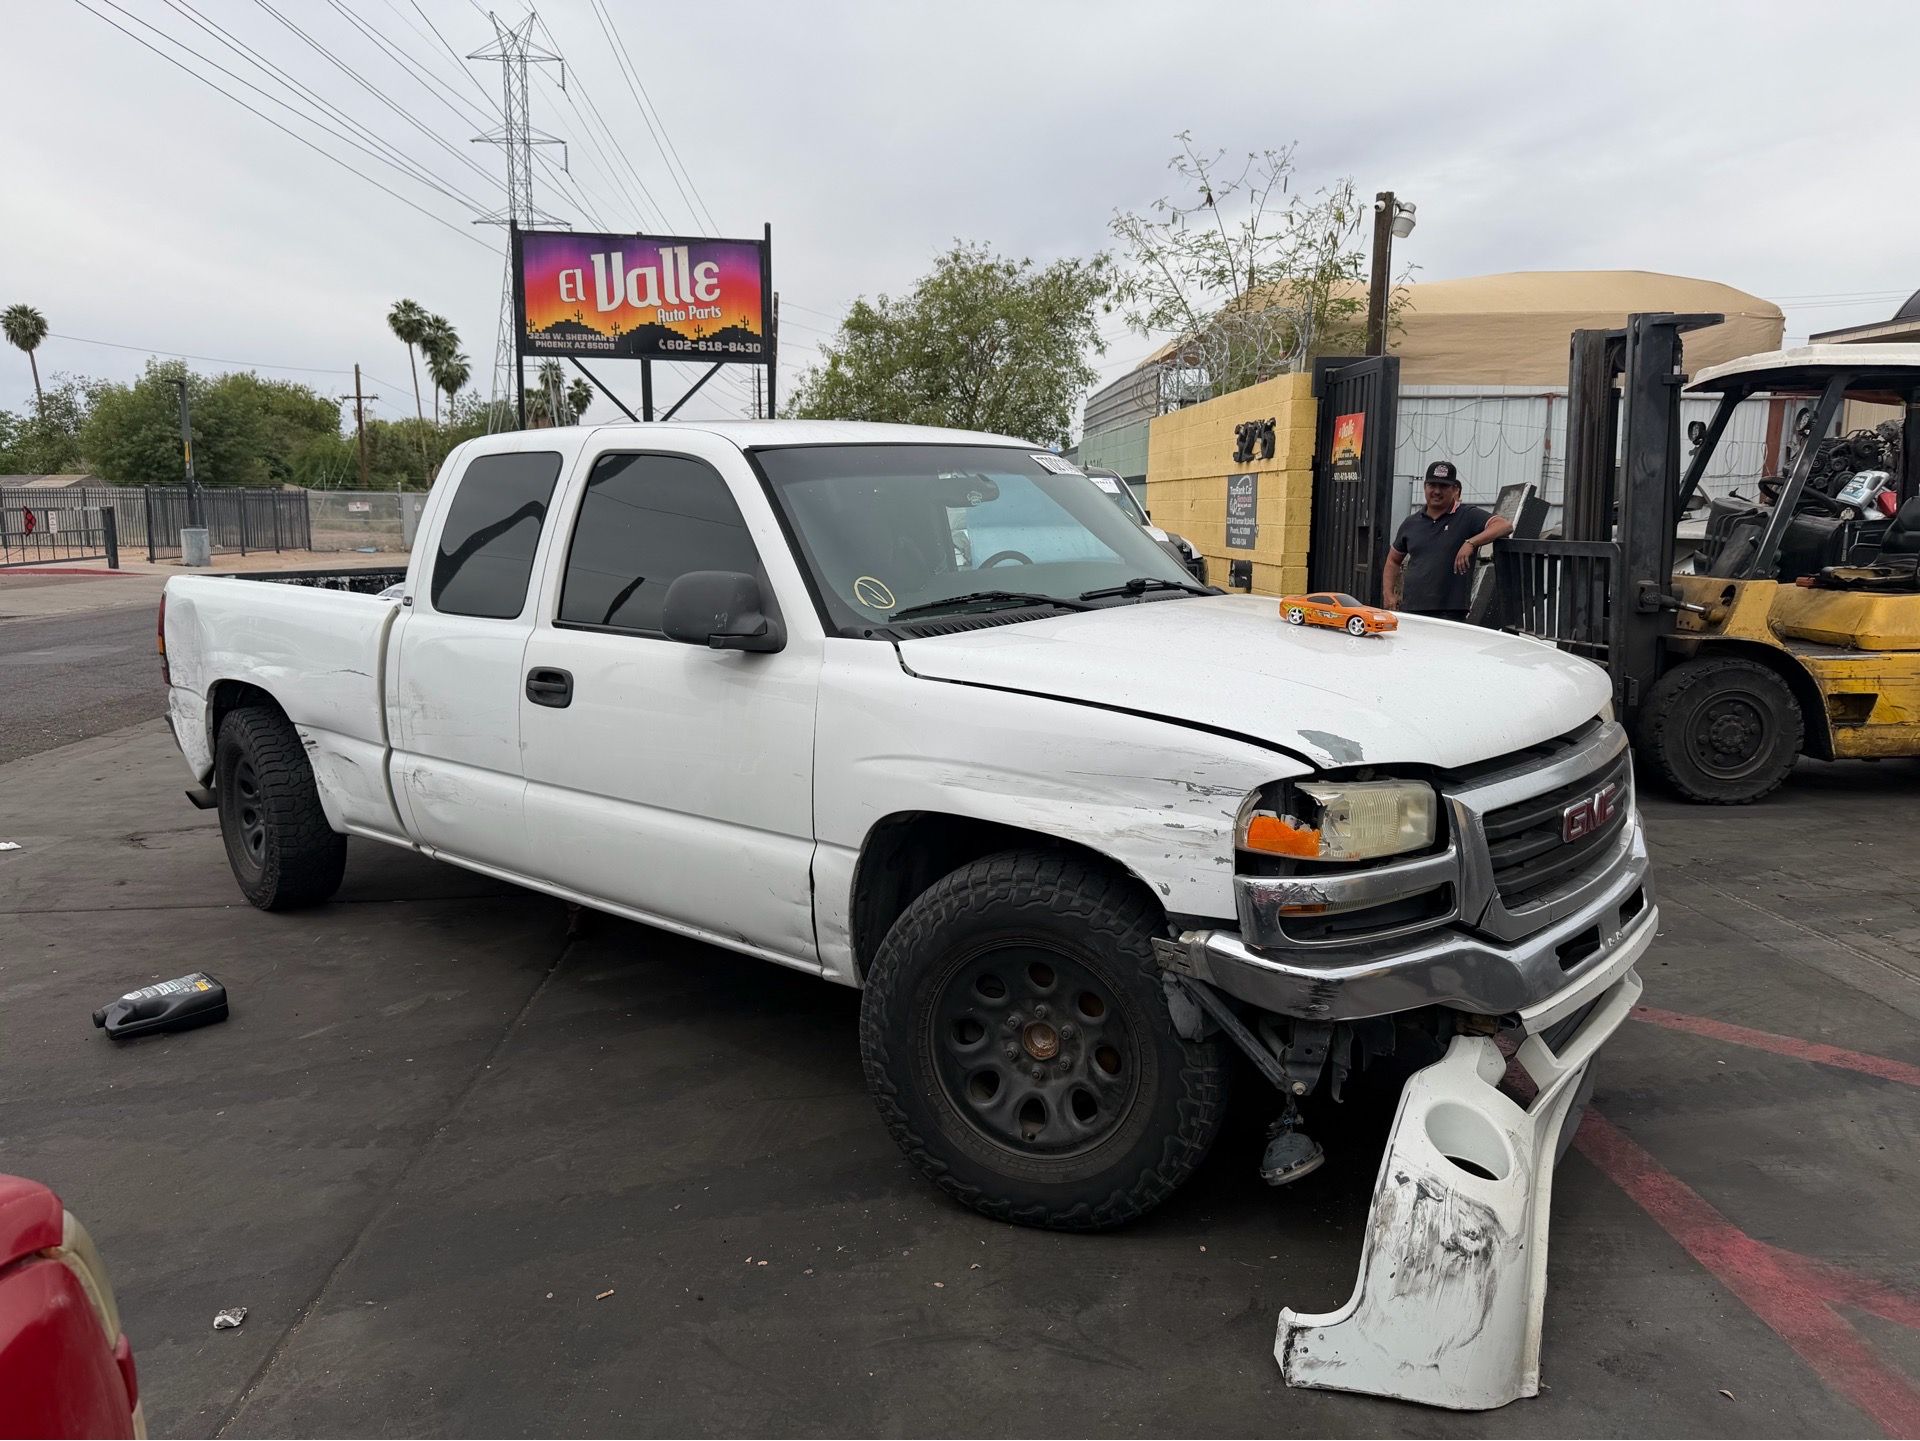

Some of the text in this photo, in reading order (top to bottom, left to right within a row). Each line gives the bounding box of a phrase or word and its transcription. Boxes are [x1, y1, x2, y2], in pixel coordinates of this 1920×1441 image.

[558, 245, 721, 313] El Valle
[657, 305, 722, 323] Auto Parts
[535, 340, 573, 349] PHOENIX
[587, 342, 616, 350] 85009
[552, 333, 564, 341] W.
[565, 333, 607, 342] SHERMAN
[666, 339, 762, 353] 602-618-8430
[1562, 782, 1616, 844] GMC
